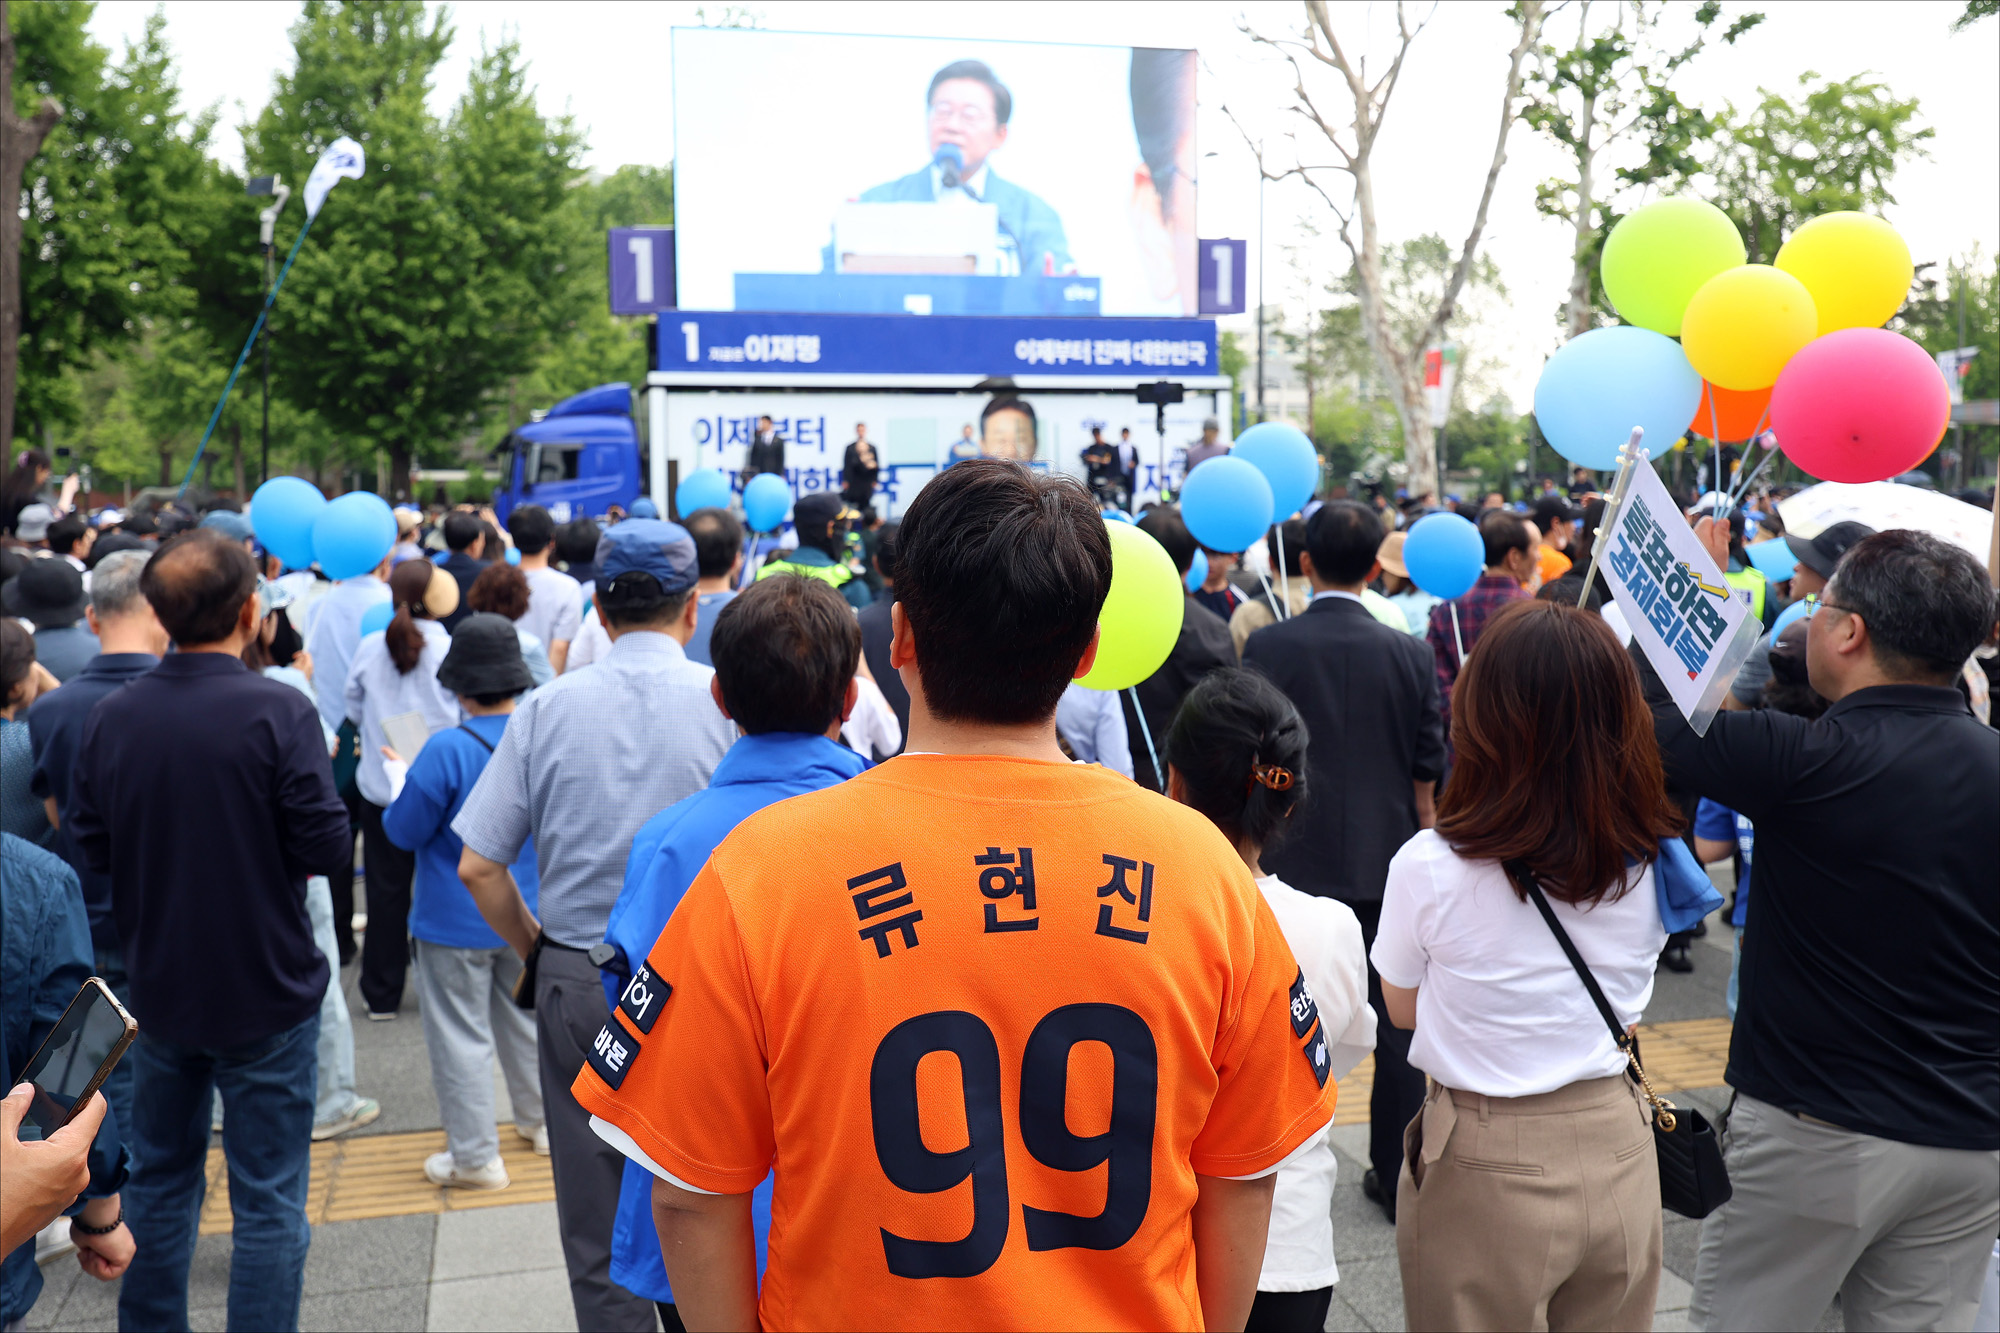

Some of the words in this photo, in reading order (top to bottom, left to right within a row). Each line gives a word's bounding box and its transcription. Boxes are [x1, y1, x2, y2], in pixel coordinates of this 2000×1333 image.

[628, 237, 654, 303] 1
[1211, 245, 1232, 306] 1
[681, 321, 700, 363] 1
[743, 334, 821, 364] 이재명
[1014, 338, 1092, 366] 이제부터
[1132, 339, 1208, 367] 대한민국
[1608, 532, 1710, 675] 경제회복
[1622, 499, 1728, 652] 투표하면
[869, 1002, 1158, 1279] 99
